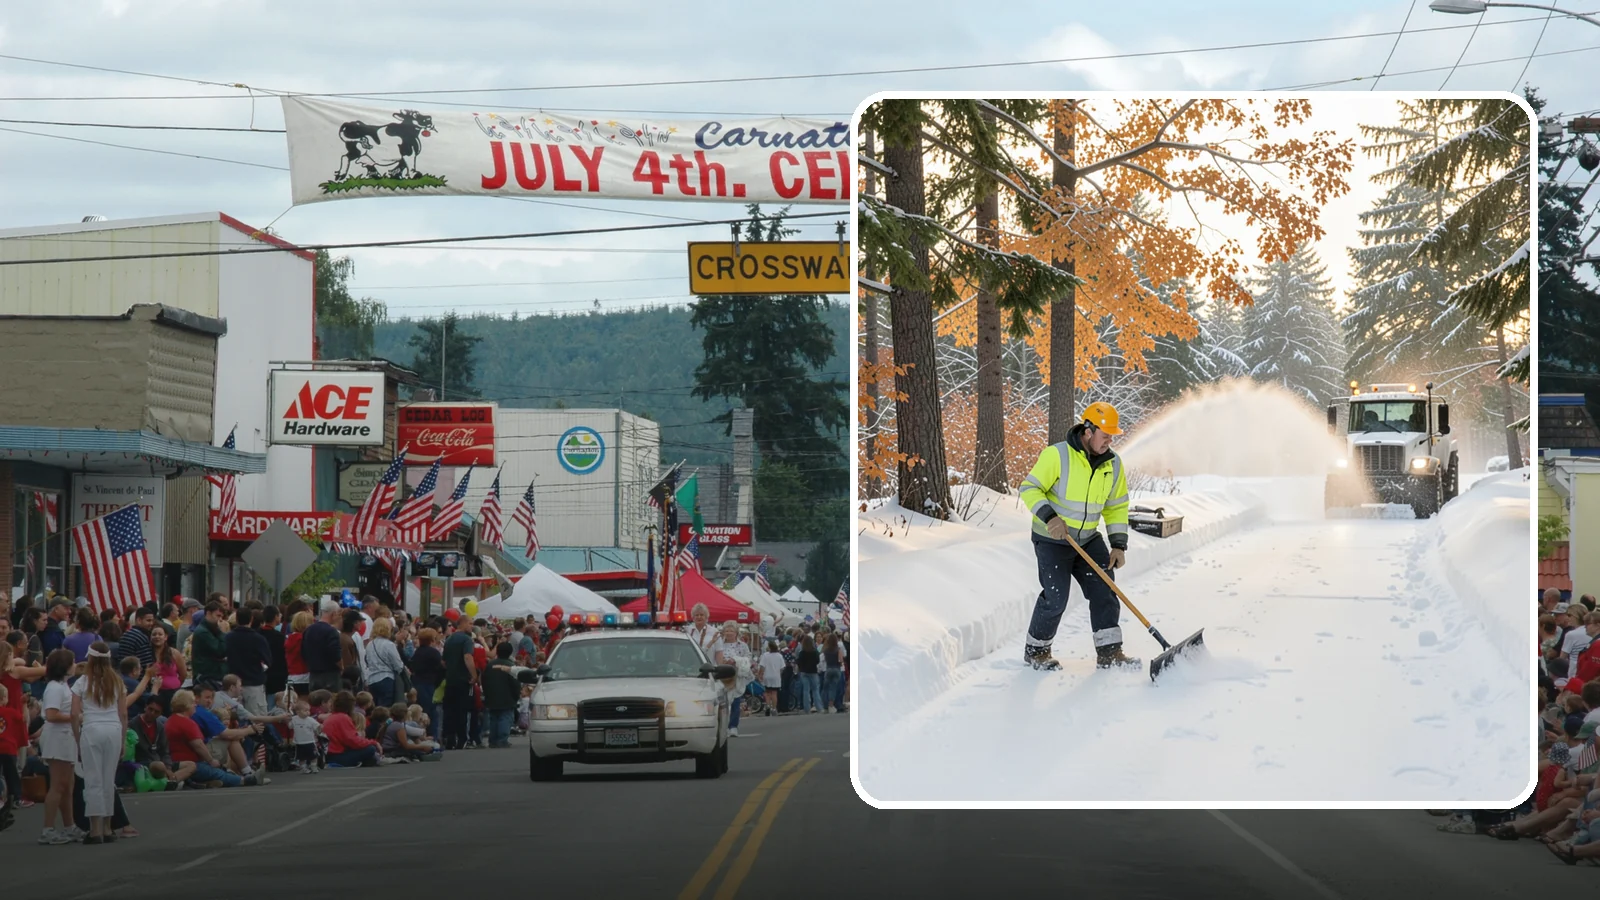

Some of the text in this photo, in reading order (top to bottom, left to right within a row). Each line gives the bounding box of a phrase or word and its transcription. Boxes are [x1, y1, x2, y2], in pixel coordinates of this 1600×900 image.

[481, 141, 605, 192] JULY
[632, 150, 746, 198] 4th.
[697, 254, 850, 280] CROSSWA
[282, 380, 373, 420] ACE
[406, 409, 451, 422] CEDAR
[283, 421, 371, 436] Hardware
[416, 428, 477, 447] Coca-Cola
[353, 467, 384, 481] Simpl
[95, 485, 124, 495] Vincent
[125, 486, 136, 495] de
[137, 486, 155, 495] Paul
[688, 526, 742, 535] CRNATION
[699, 535, 730, 543] GLASS
